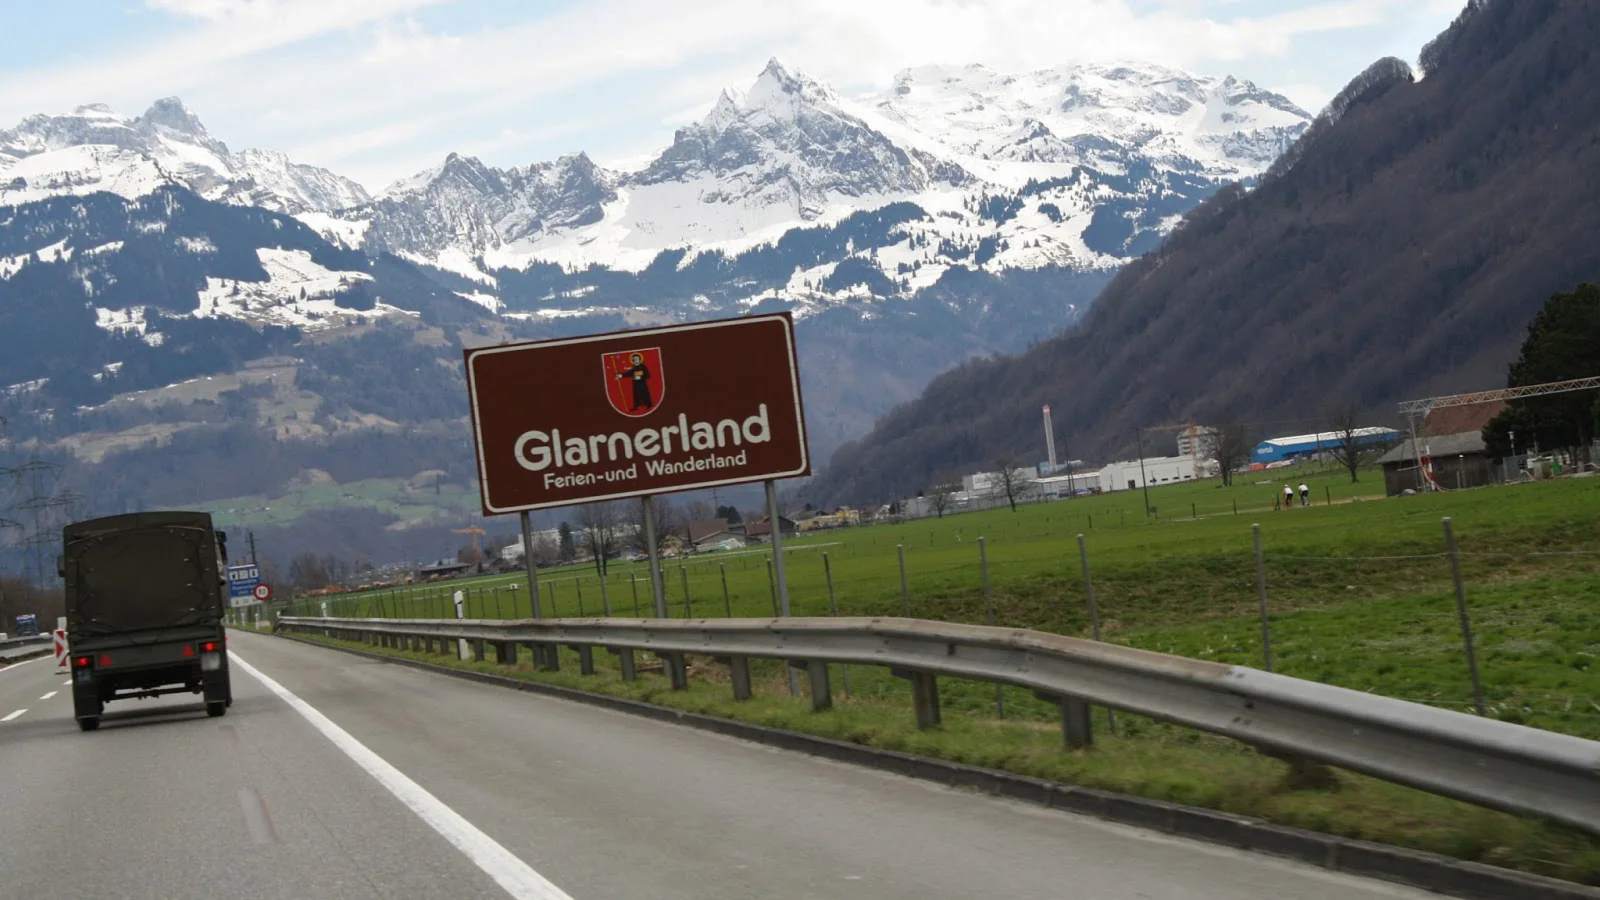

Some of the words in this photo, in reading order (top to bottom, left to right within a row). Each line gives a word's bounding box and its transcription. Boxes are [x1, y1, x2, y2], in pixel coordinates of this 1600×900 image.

[514, 403, 771, 472] Glarnerland
[543, 464, 638, 490] Ferien-und
[645, 449, 747, 477] Wanderland
